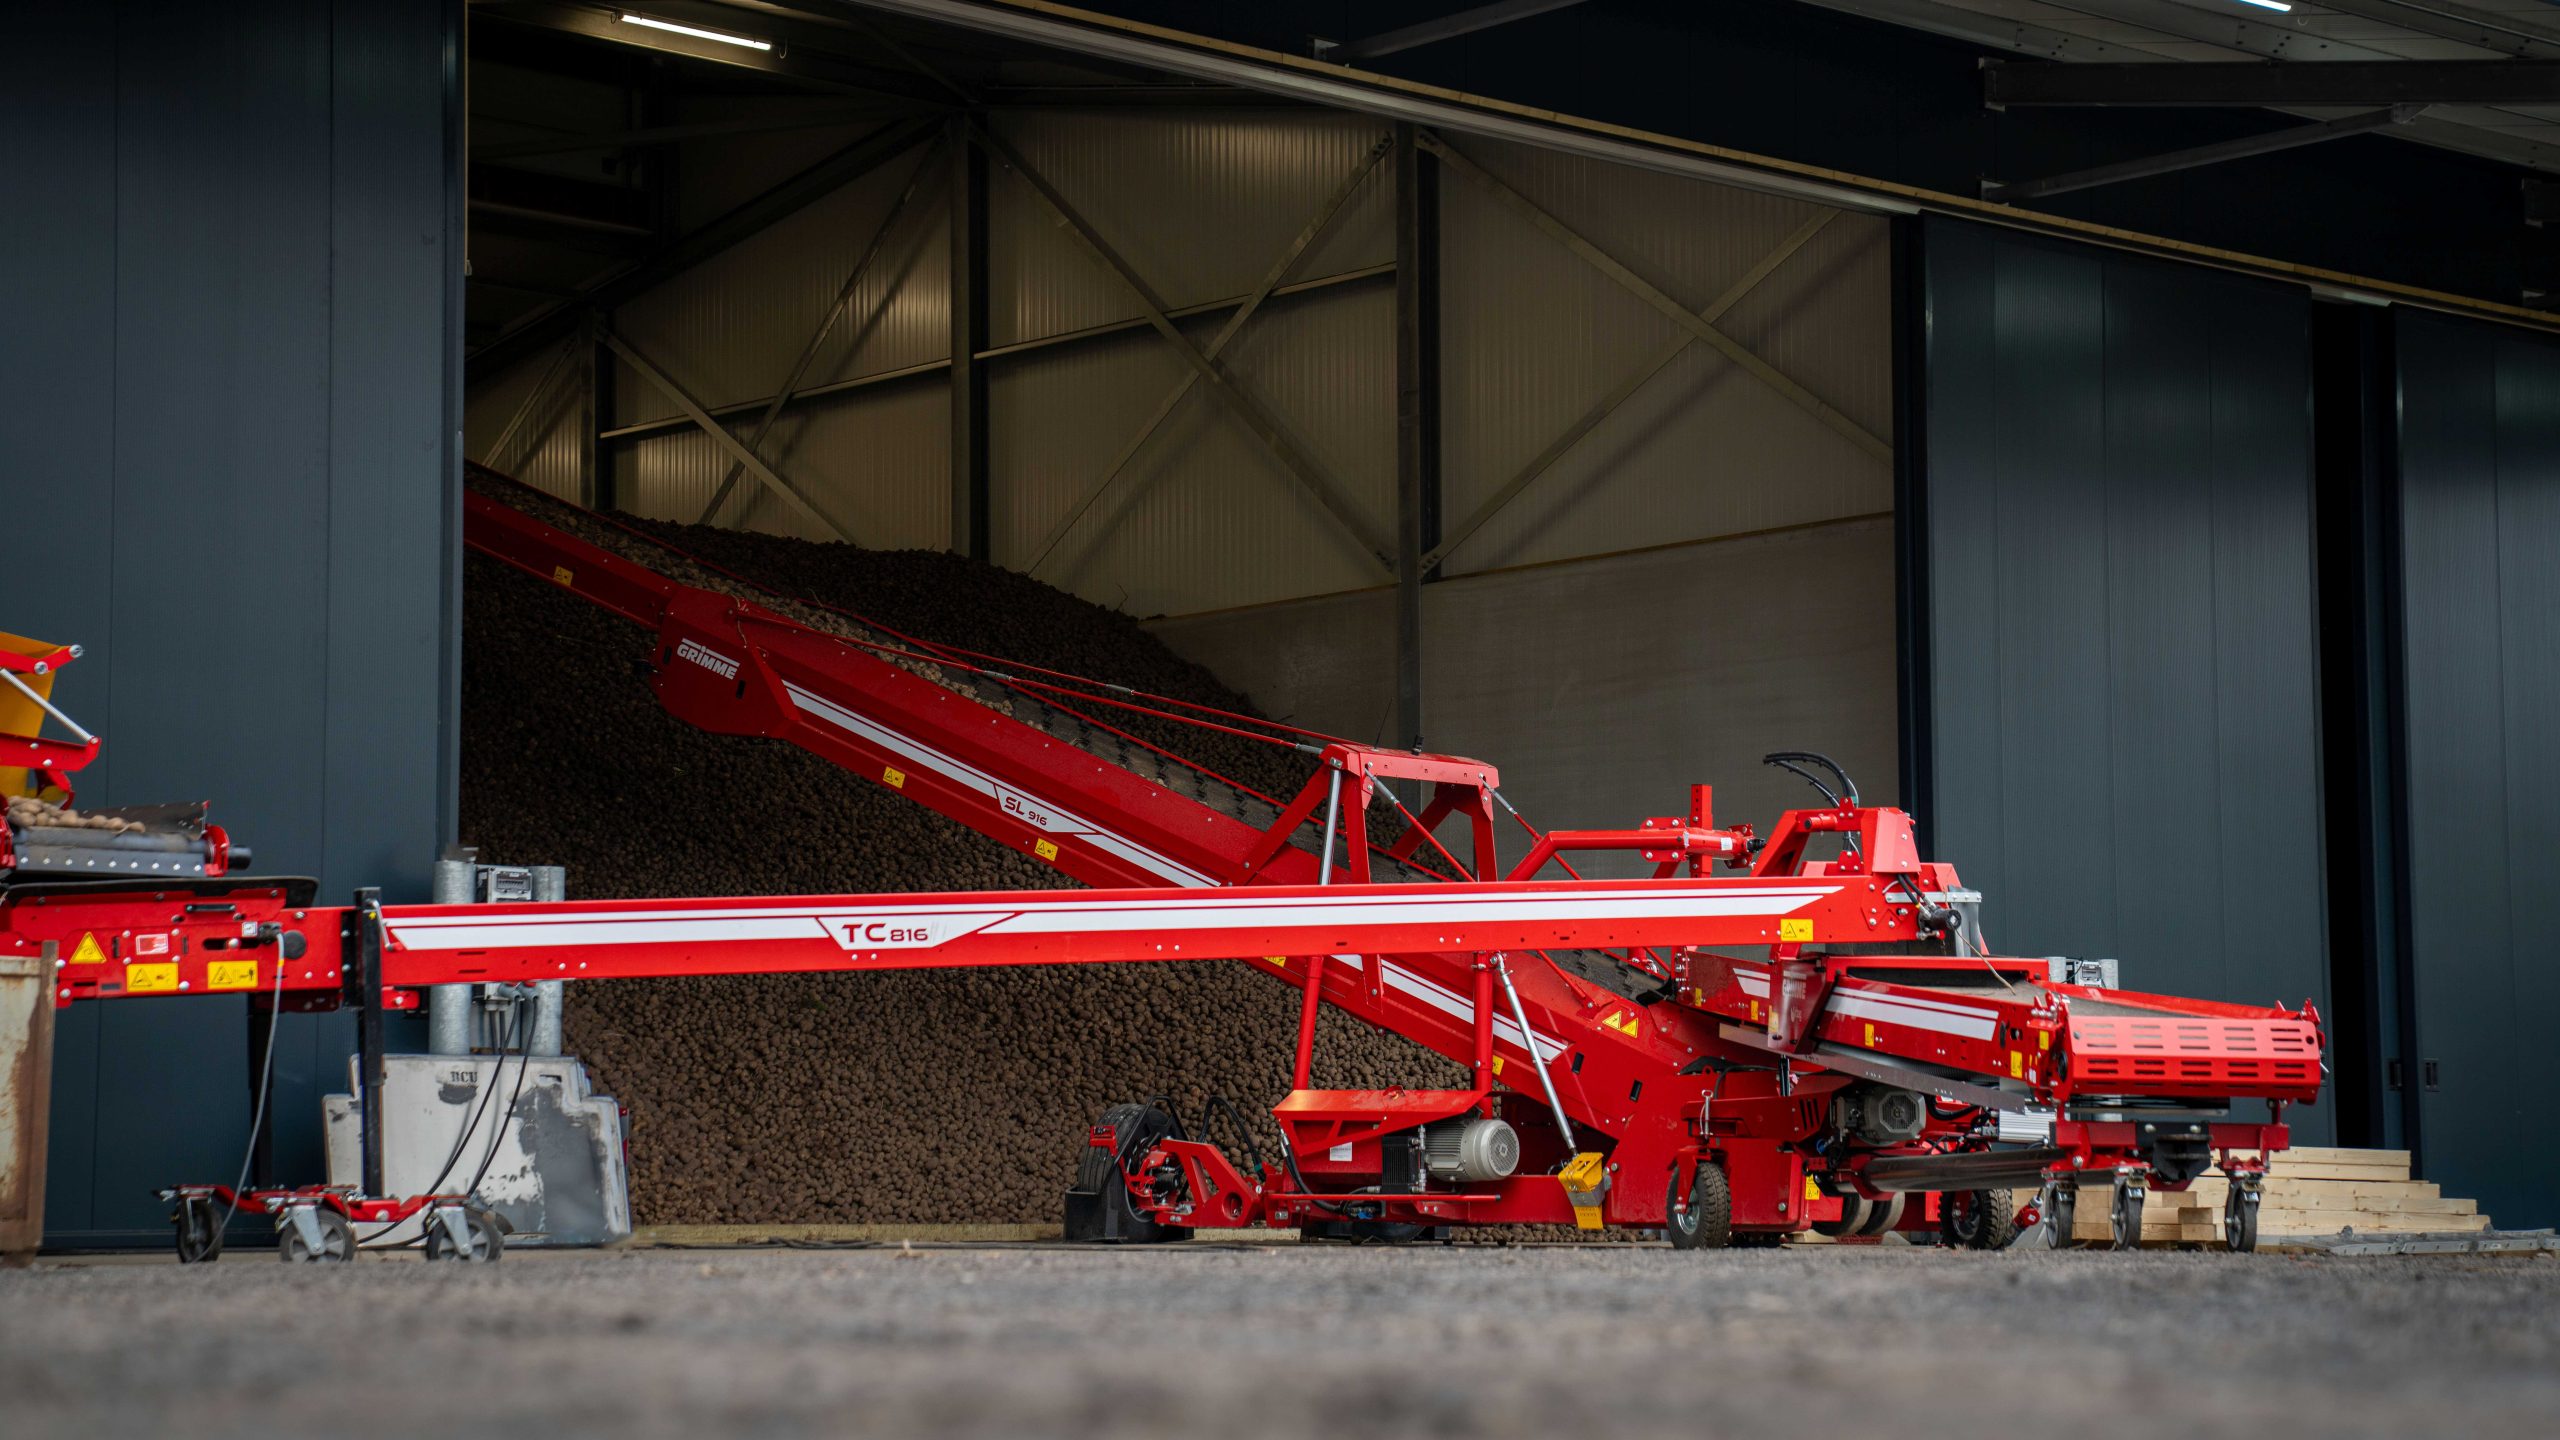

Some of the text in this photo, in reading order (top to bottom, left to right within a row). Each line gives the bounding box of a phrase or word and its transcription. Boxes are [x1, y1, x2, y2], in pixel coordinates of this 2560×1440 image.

[677, 642, 739, 680] GRIMME
[1004, 796, 1048, 826] SL 916
[842, 923, 928, 943] TC 816
